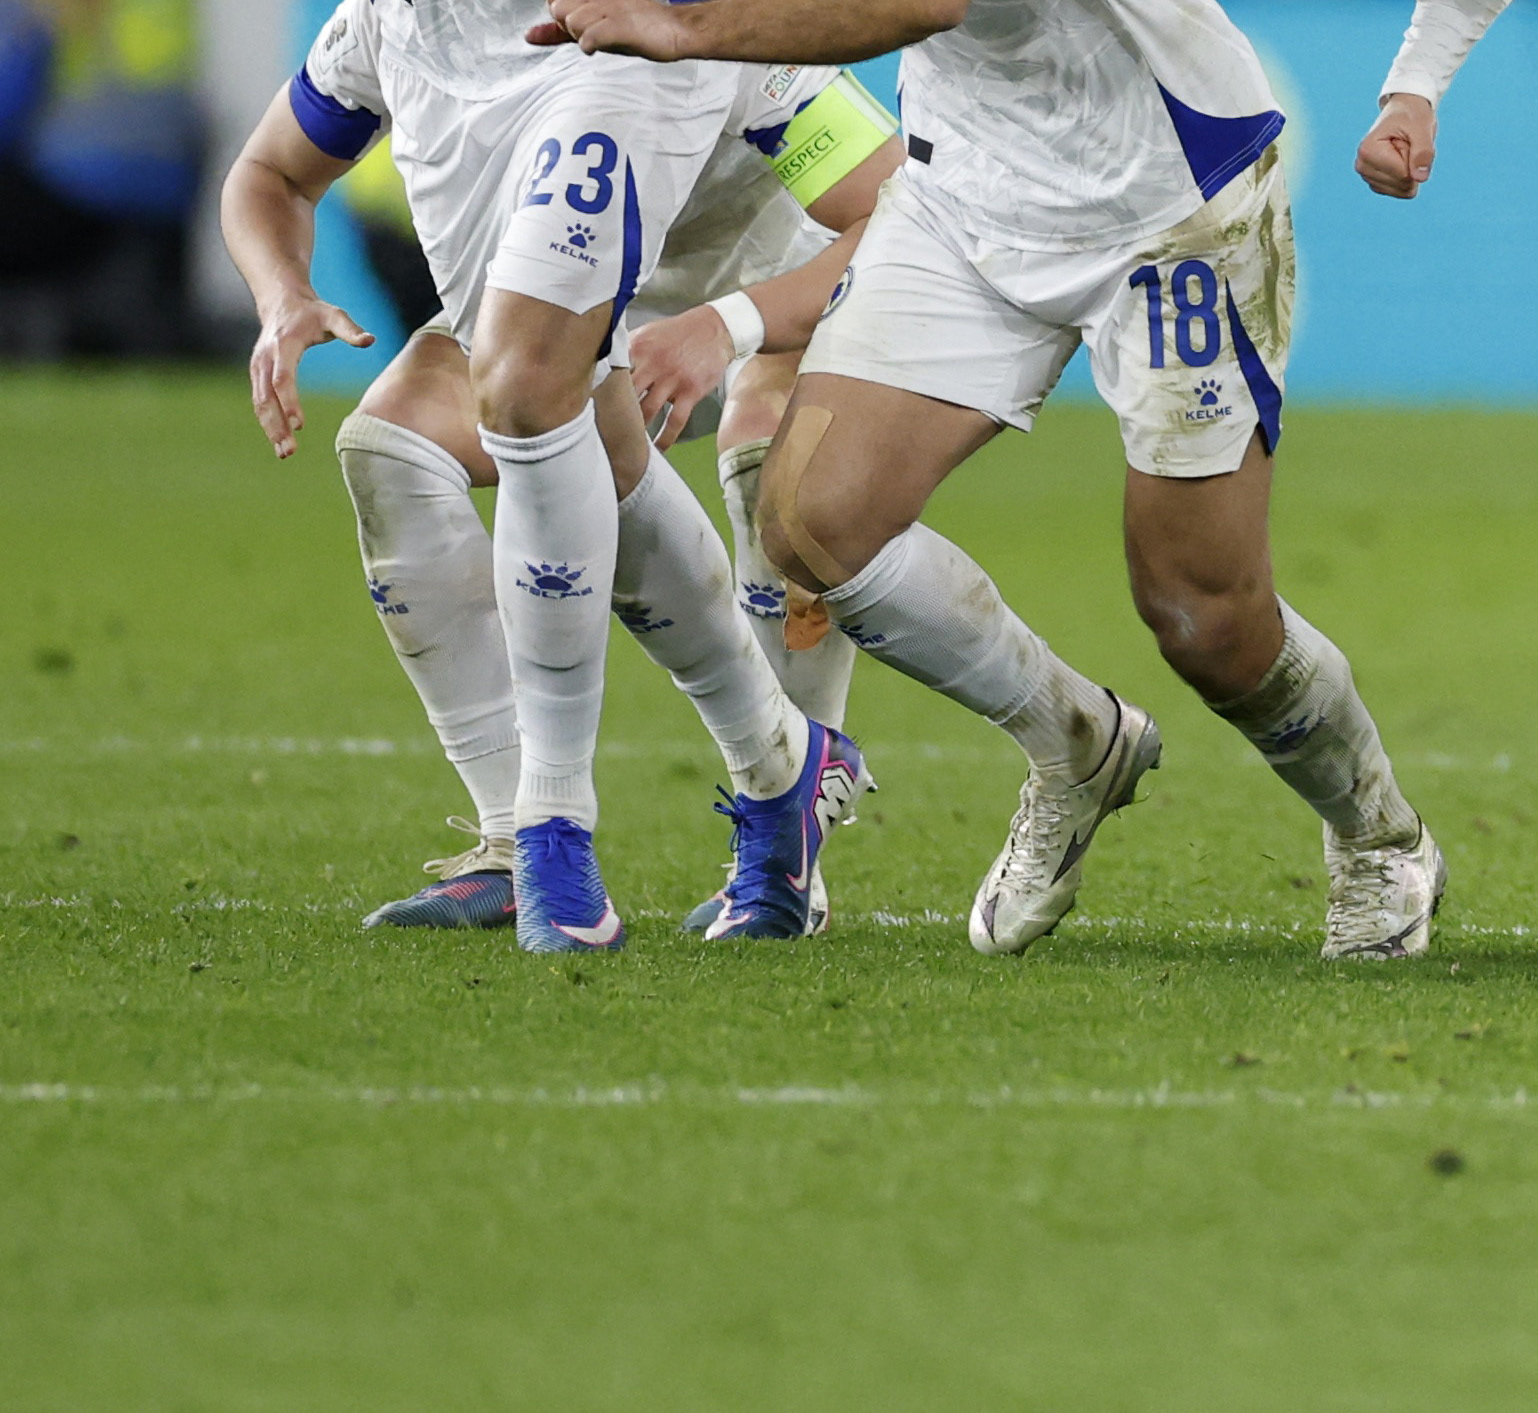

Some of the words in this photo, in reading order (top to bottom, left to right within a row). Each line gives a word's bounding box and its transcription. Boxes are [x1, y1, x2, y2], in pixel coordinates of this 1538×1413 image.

[520, 132, 618, 215] 23
[778, 130, 835, 181] RESPECT
[549, 242, 598, 267] KELME
[1130, 260, 1221, 370] 18
[1185, 406, 1232, 420] KELME
[515, 579, 594, 599] KELME
